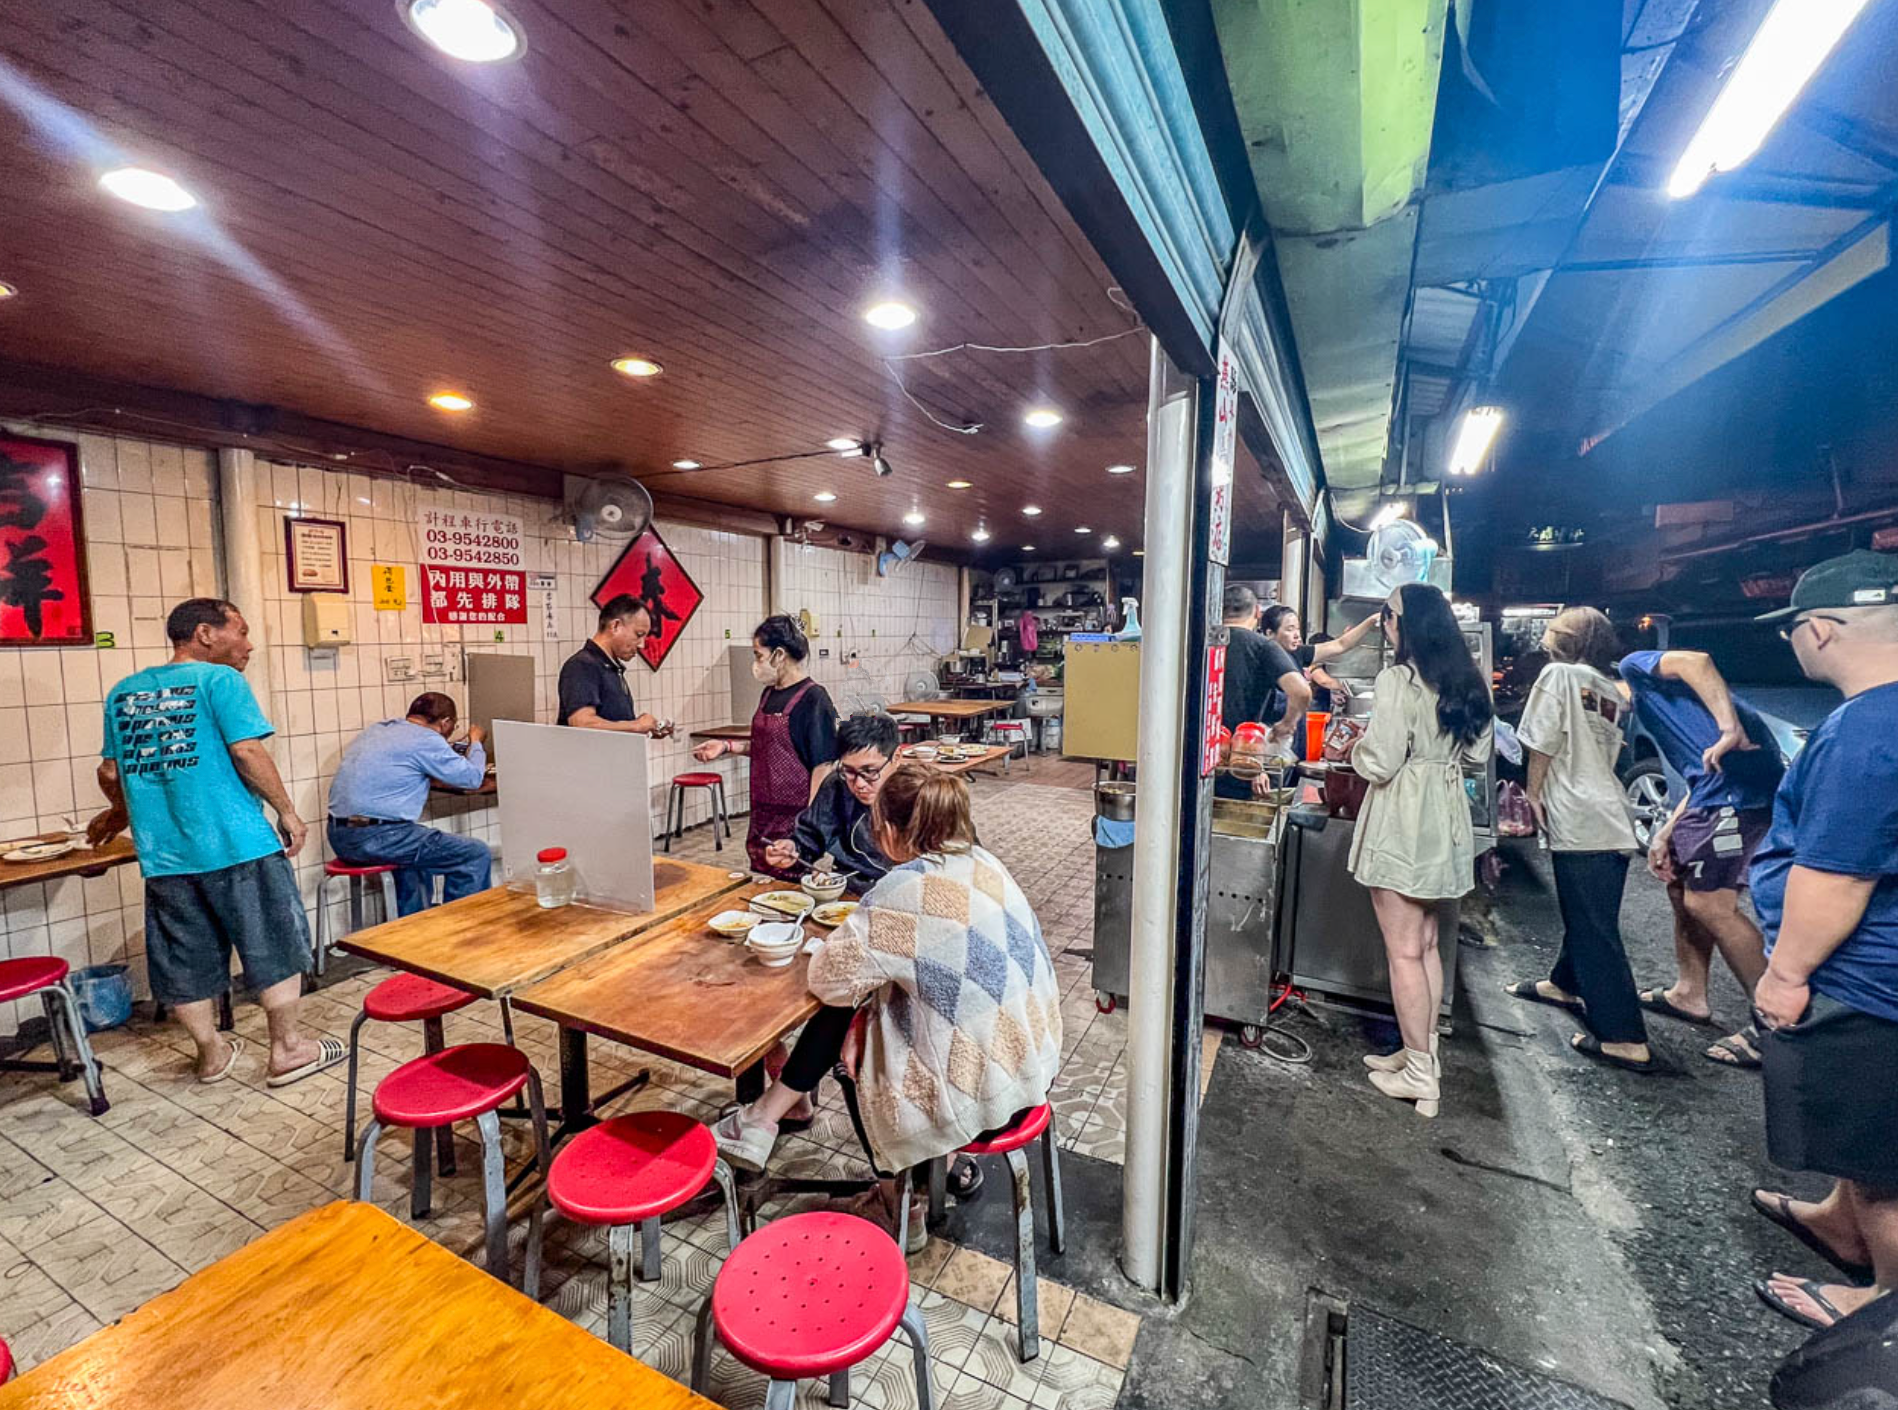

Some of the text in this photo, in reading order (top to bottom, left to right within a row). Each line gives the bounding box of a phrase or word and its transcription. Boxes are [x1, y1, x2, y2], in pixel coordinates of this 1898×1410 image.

[424, 511, 518, 534] 計程車行電話
[426, 529, 519, 550] 03-9542800
[428, 546, 519, 566] 03-9542850
[431, 591, 520, 609] 都先排隊
[495, 630, 504, 643] 4
[1687, 860, 1705, 878] 7
